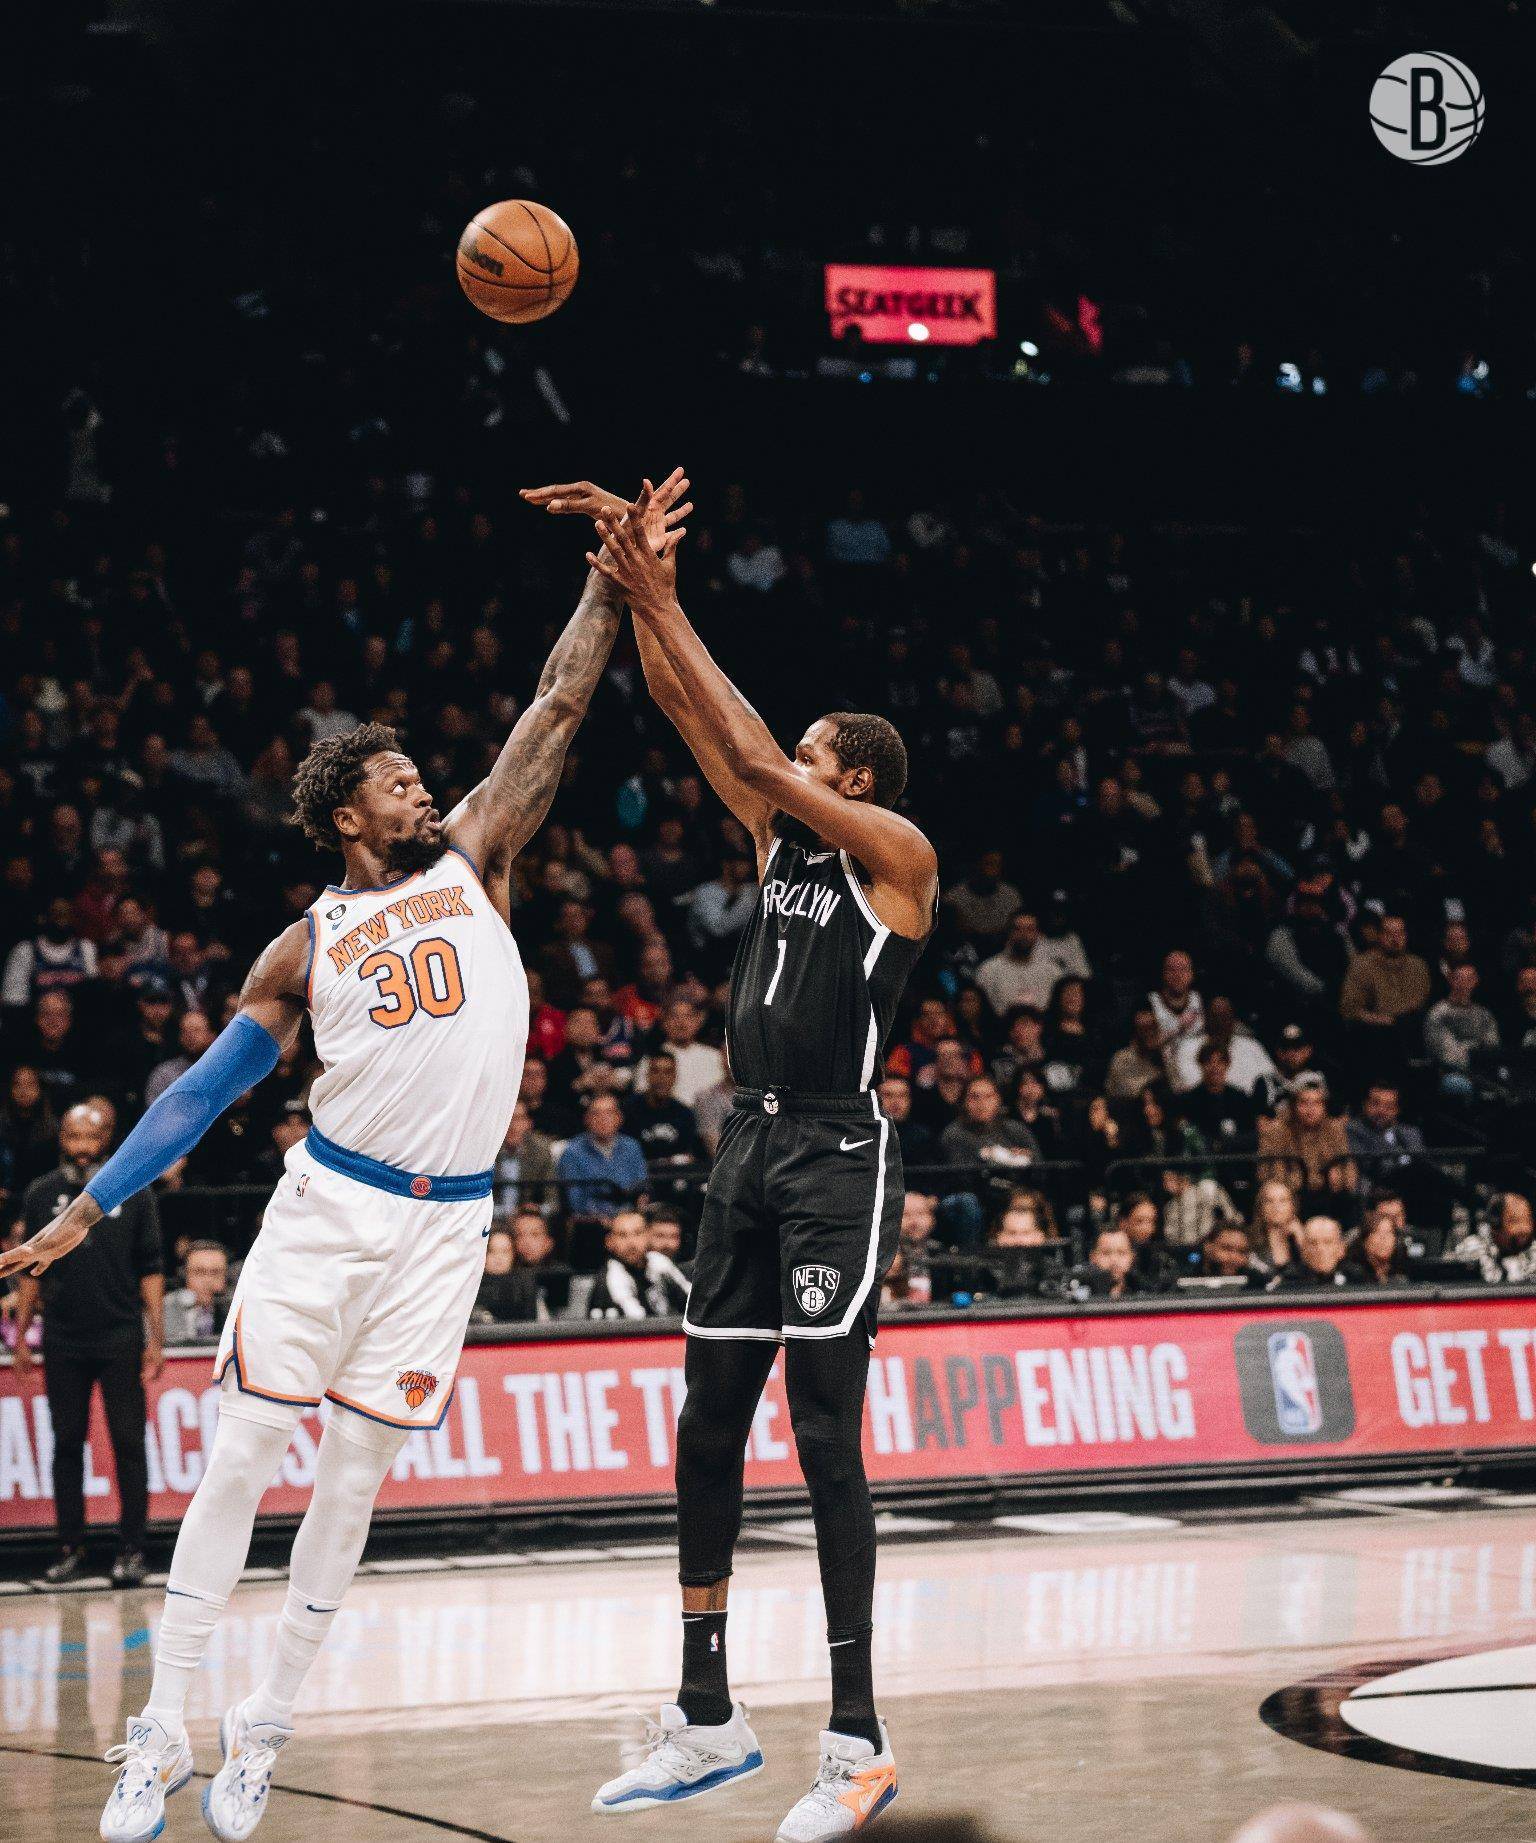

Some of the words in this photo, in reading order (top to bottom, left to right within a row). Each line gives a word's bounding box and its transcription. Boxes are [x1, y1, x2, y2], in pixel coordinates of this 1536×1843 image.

[326, 910, 390, 976] NEW
[385, 885, 474, 930] YORK
[763, 939, 787, 1006] 1
[357, 936, 467, 1030] 30
[795, 1267, 837, 1290] NETS
[809, 1290, 817, 1309] B
[503, 1369, 629, 1474] THE
[865, 1342, 1196, 1454] HAPPENING
[1390, 1329, 1492, 1428] GET
